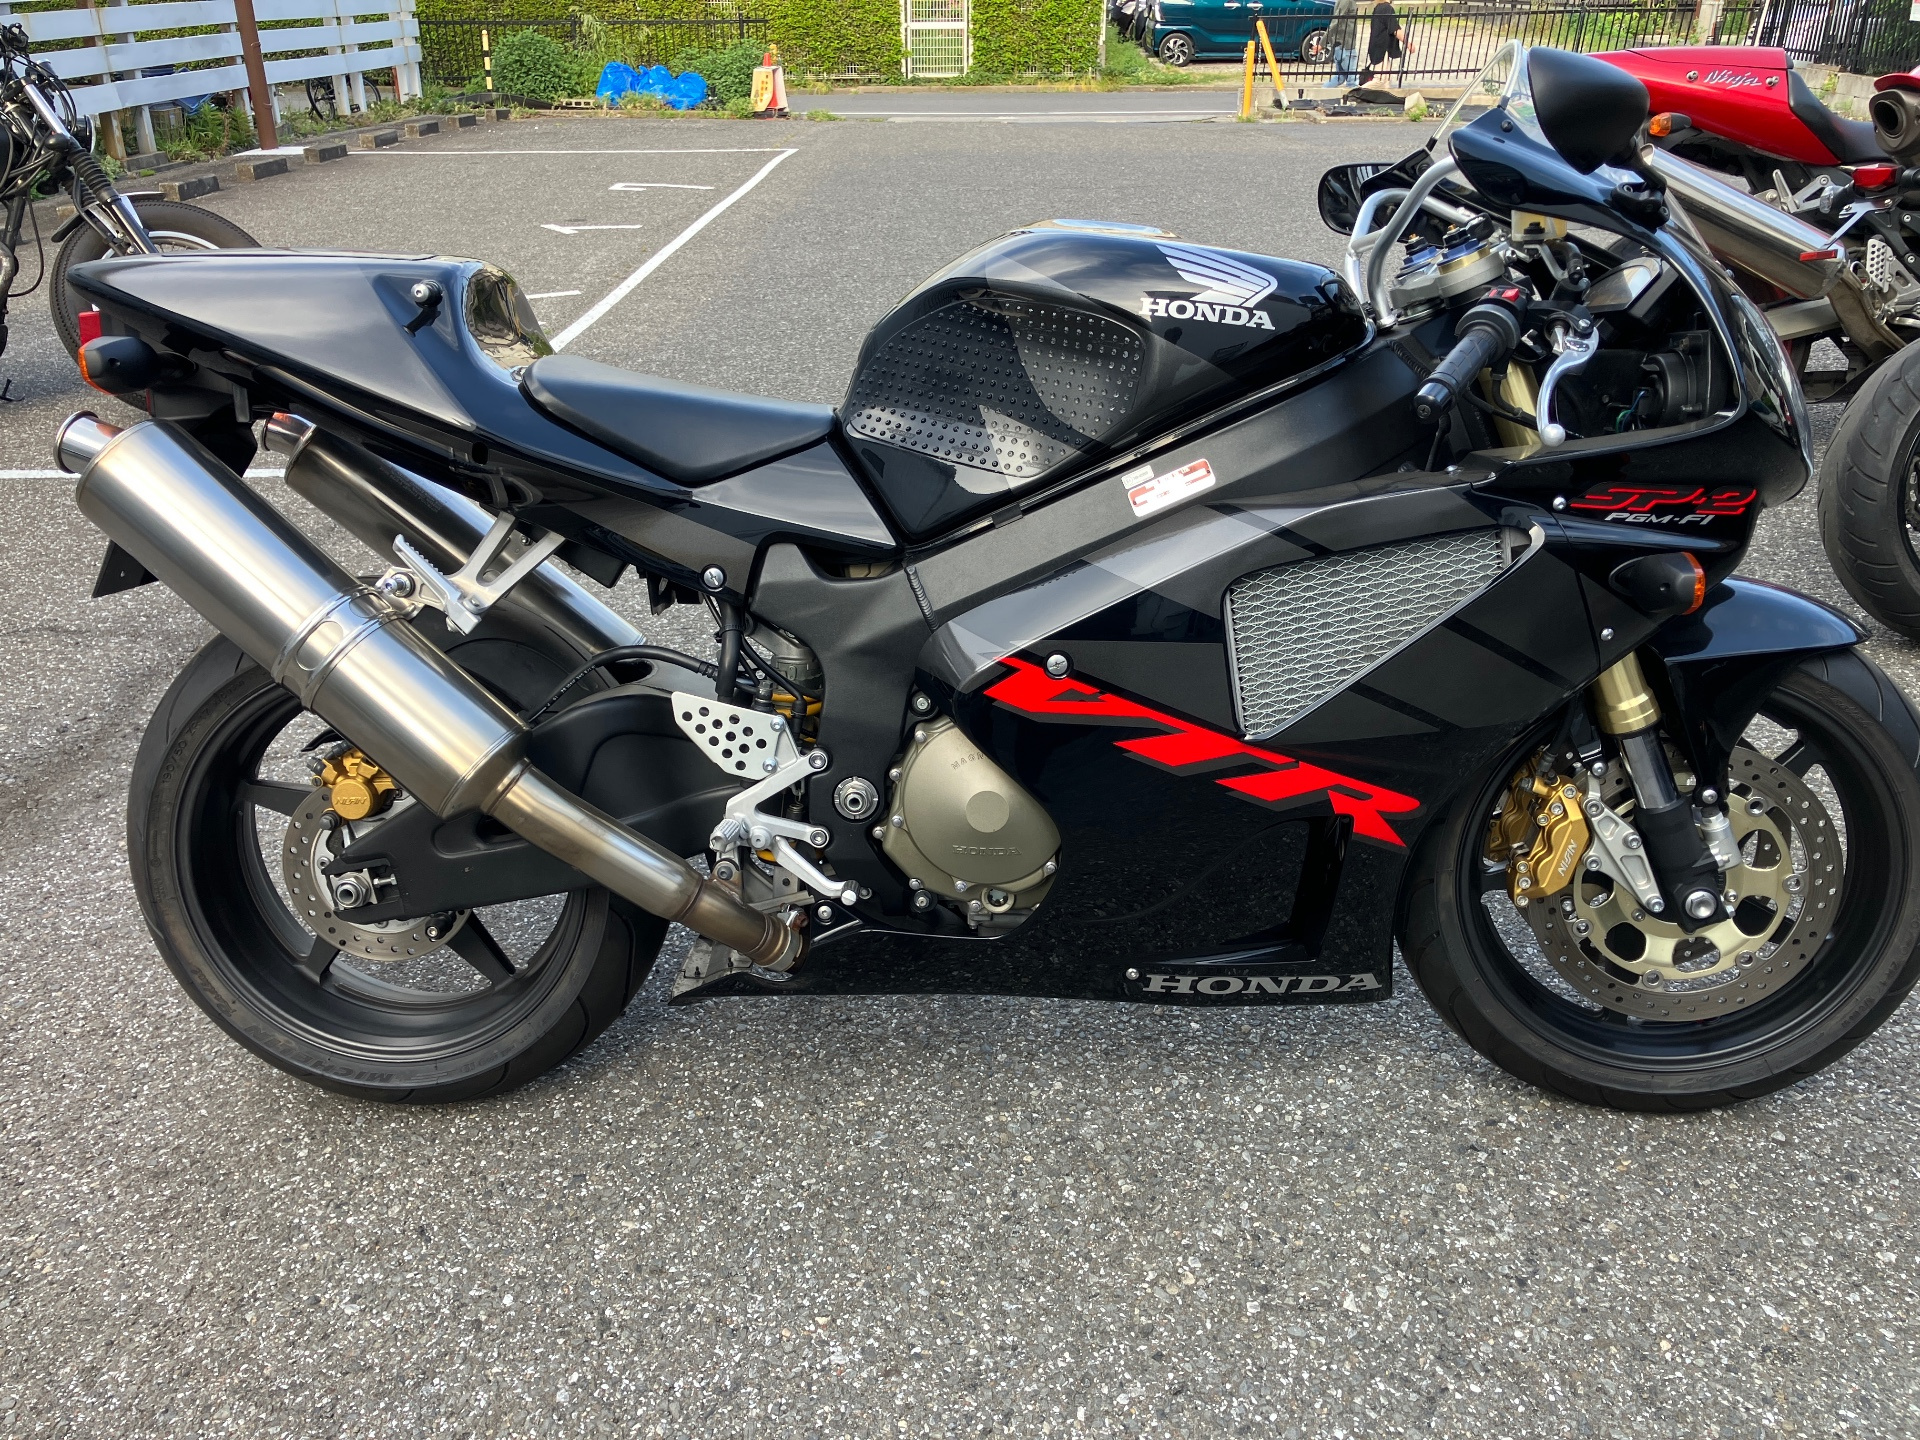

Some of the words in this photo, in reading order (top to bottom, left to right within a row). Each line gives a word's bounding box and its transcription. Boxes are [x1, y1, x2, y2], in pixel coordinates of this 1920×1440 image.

[1703, 69, 1763, 90] Ninja
[1138, 297, 1276, 331] HONDA
[952, 844, 1022, 857] HONDA
[1143, 972, 1383, 995] HONDA
